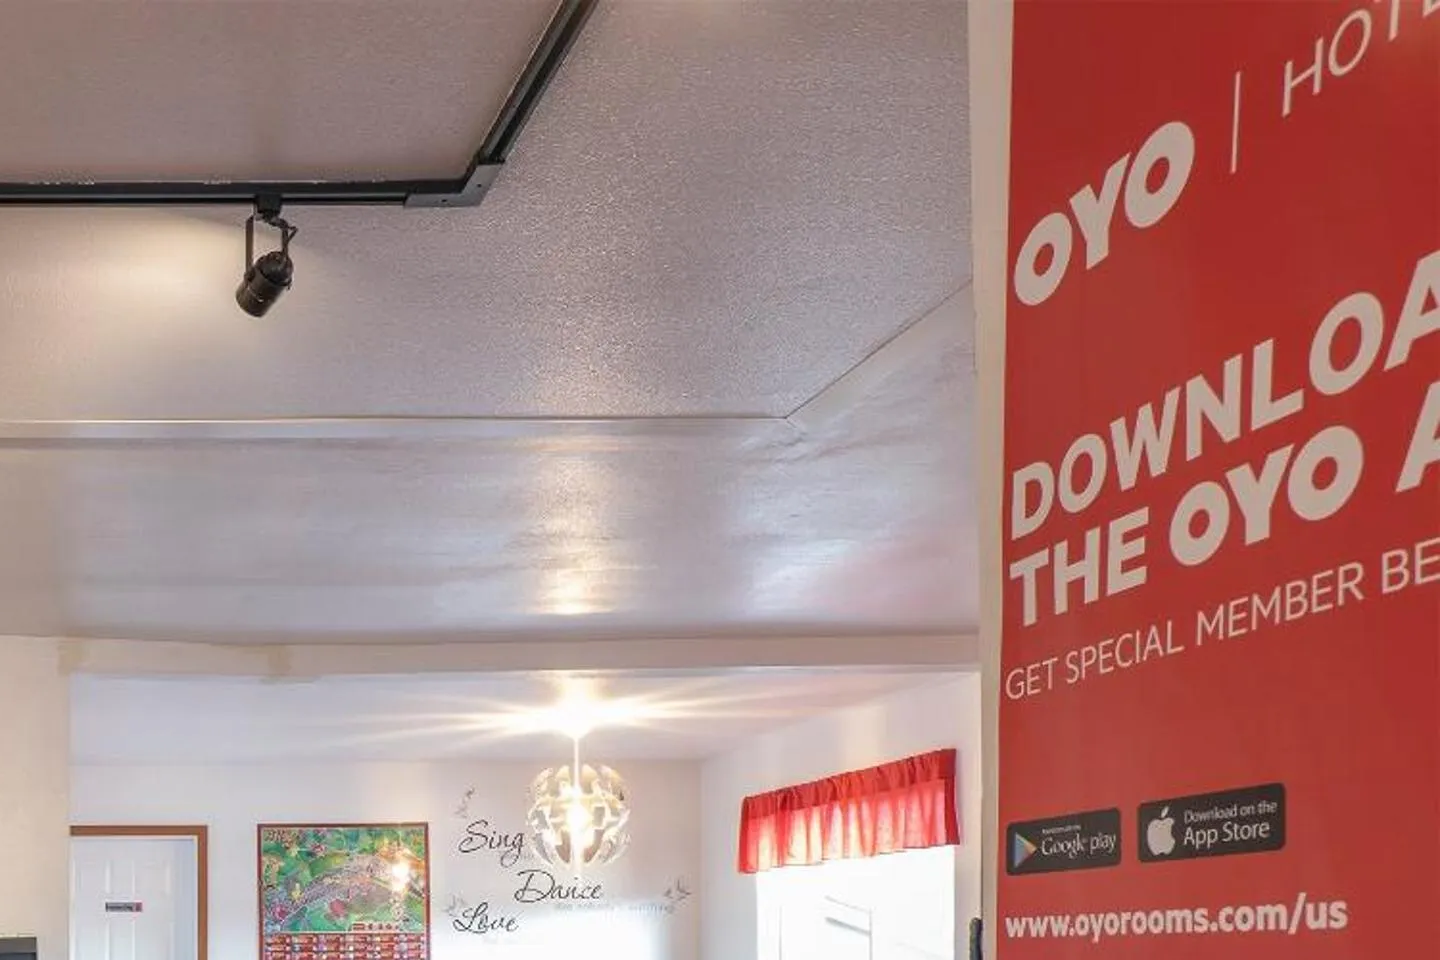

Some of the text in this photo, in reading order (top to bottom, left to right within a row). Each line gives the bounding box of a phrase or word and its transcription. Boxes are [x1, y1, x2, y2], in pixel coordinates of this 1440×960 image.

[1014, 0, 1440, 307] OYO HOT
[1009, 506, 1150, 628] THE
[1169, 425, 1364, 567] OYO
[1005, 657, 1059, 700] GET
[1065, 620, 1185, 684] SPECIAL
[1196, 561, 1364, 646] MEMBER
[1183, 800, 1278, 824] Download on the
[458, 819, 525, 868] Sing
[1089, 831, 1117, 855] play
[1183, 820, 1271, 850] App Store
[514, 869, 604, 903] Dance
[452, 901, 520, 934] Love
[1005, 891, 1348, 944] www.oyorooms.com/us
